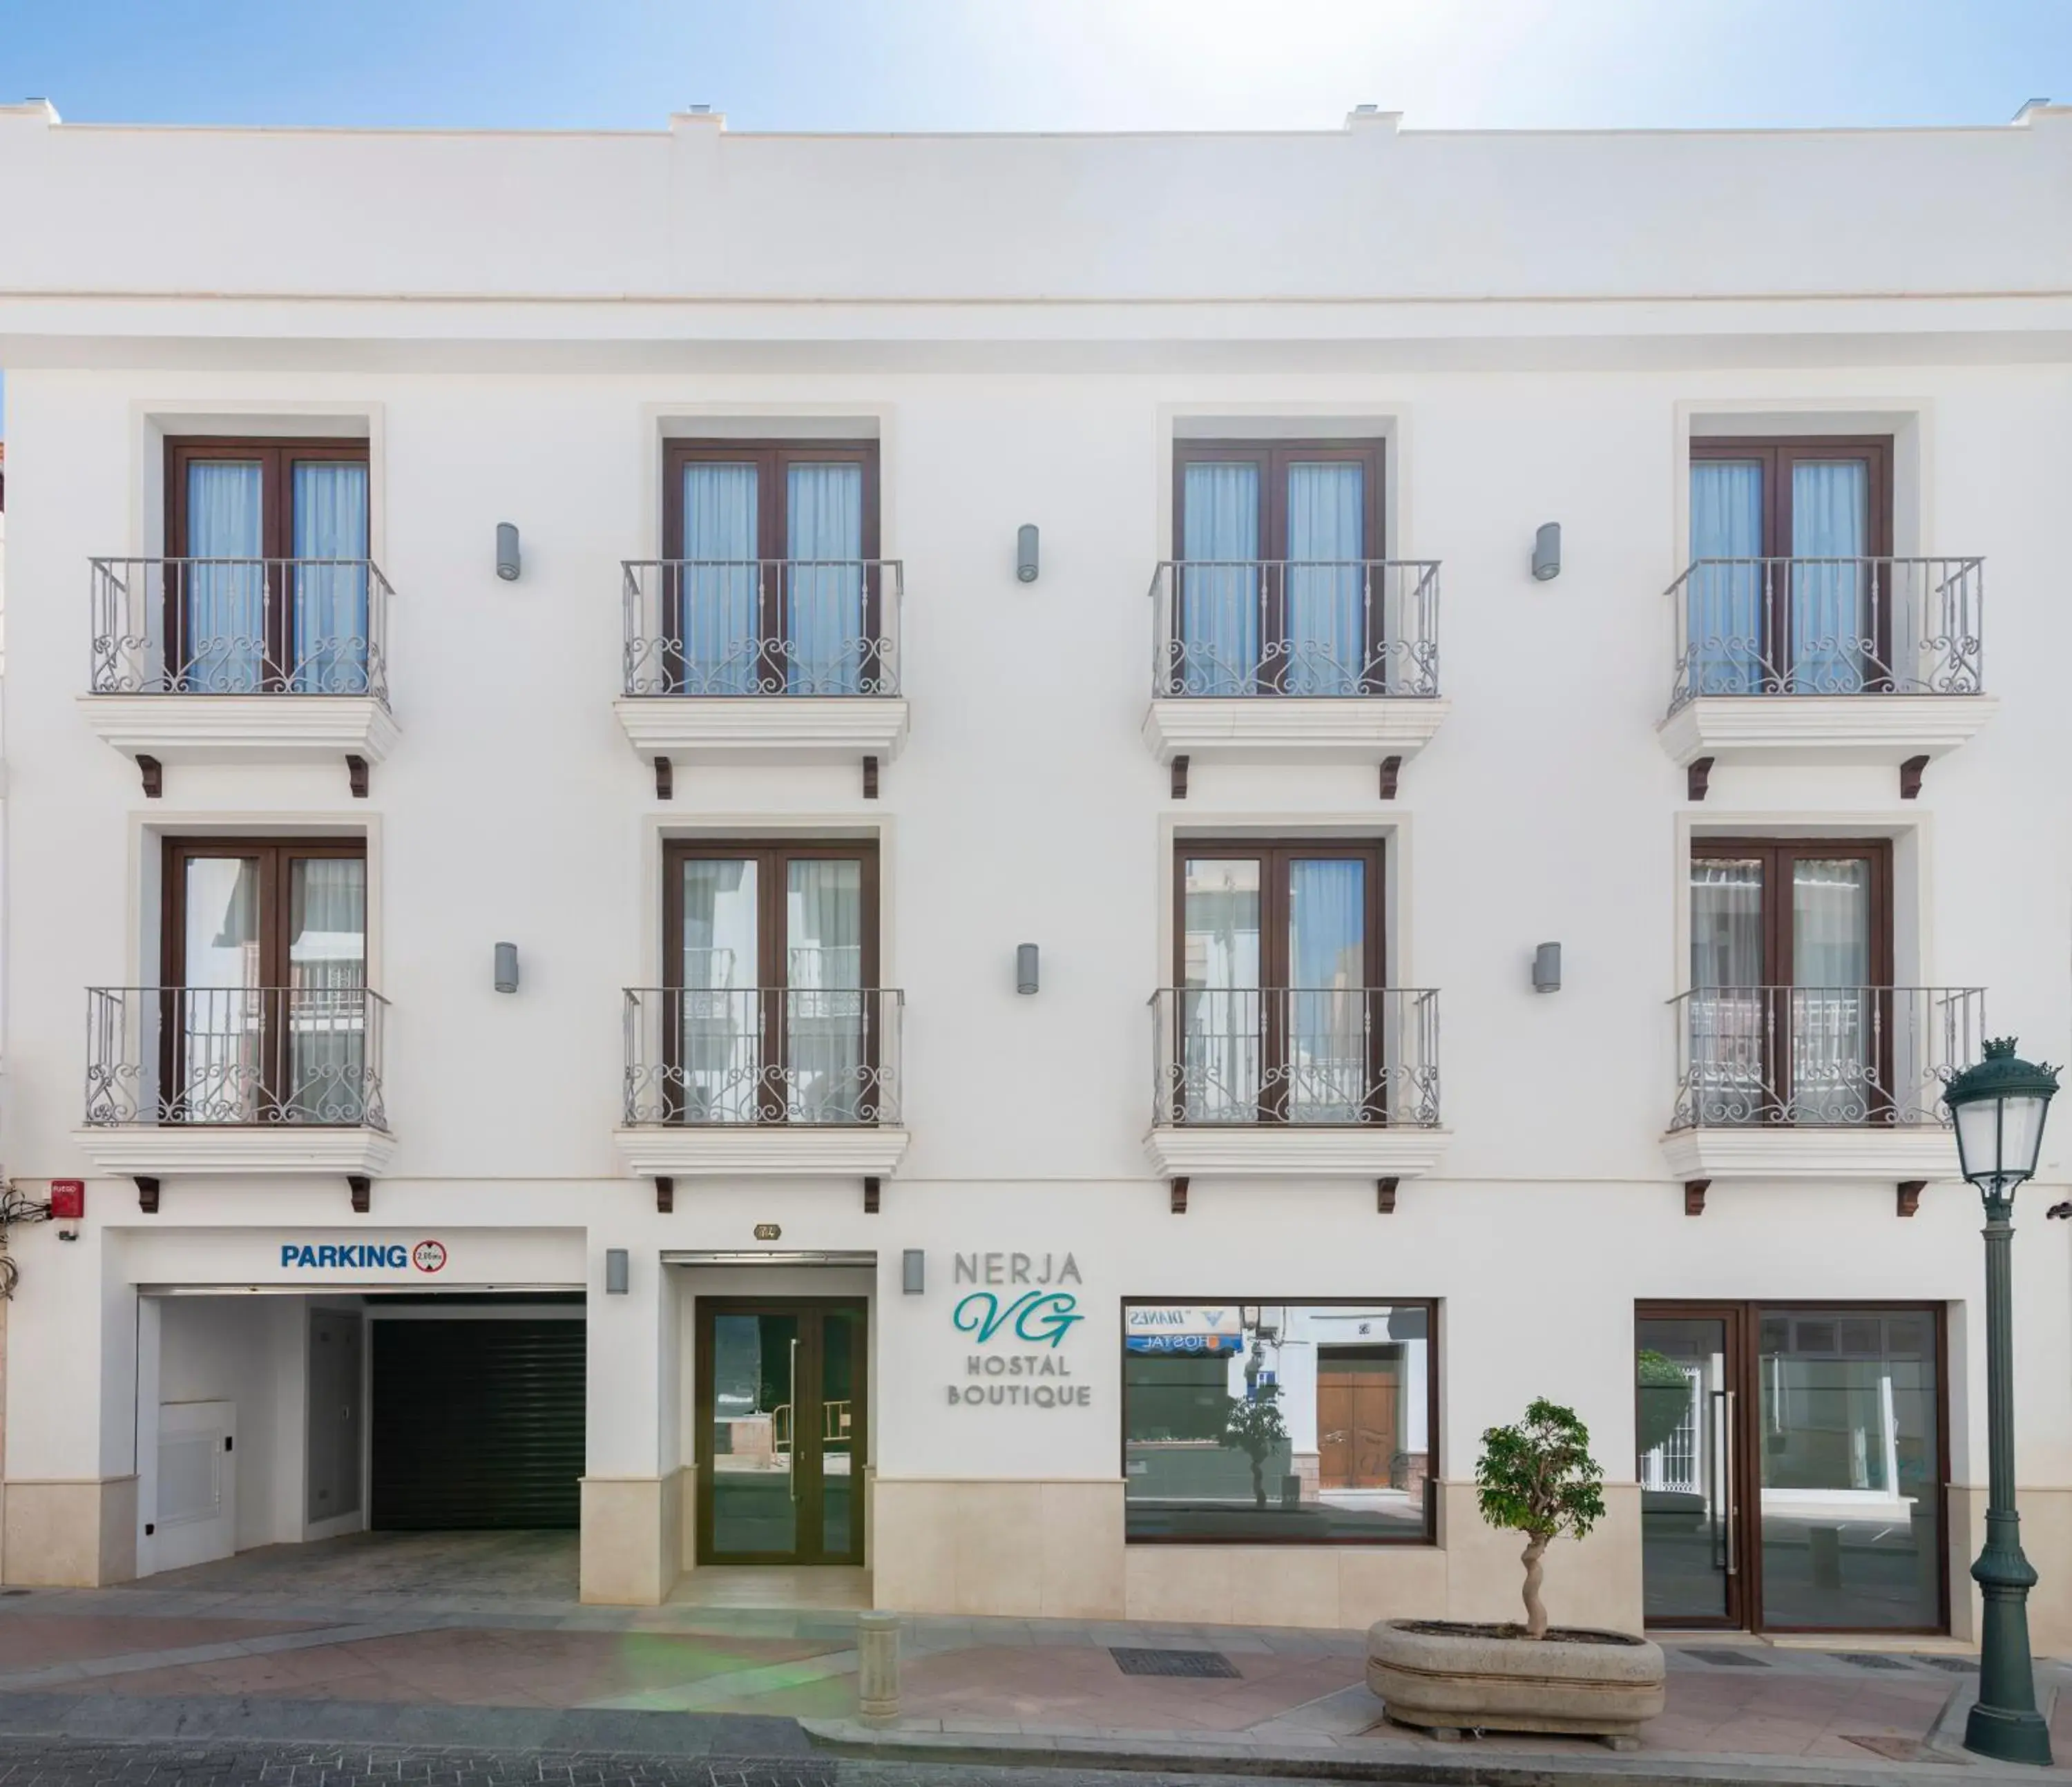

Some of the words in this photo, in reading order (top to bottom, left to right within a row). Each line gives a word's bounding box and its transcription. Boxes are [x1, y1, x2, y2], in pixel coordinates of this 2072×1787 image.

[281, 1245, 407, 1268] PARKING
[955, 1252, 1083, 1284] NERJA
[953, 1289, 1085, 1348] VG
[967, 1354, 1072, 1375] HOSTAL
[947, 1384, 1091, 1408] BOUTIQUE
